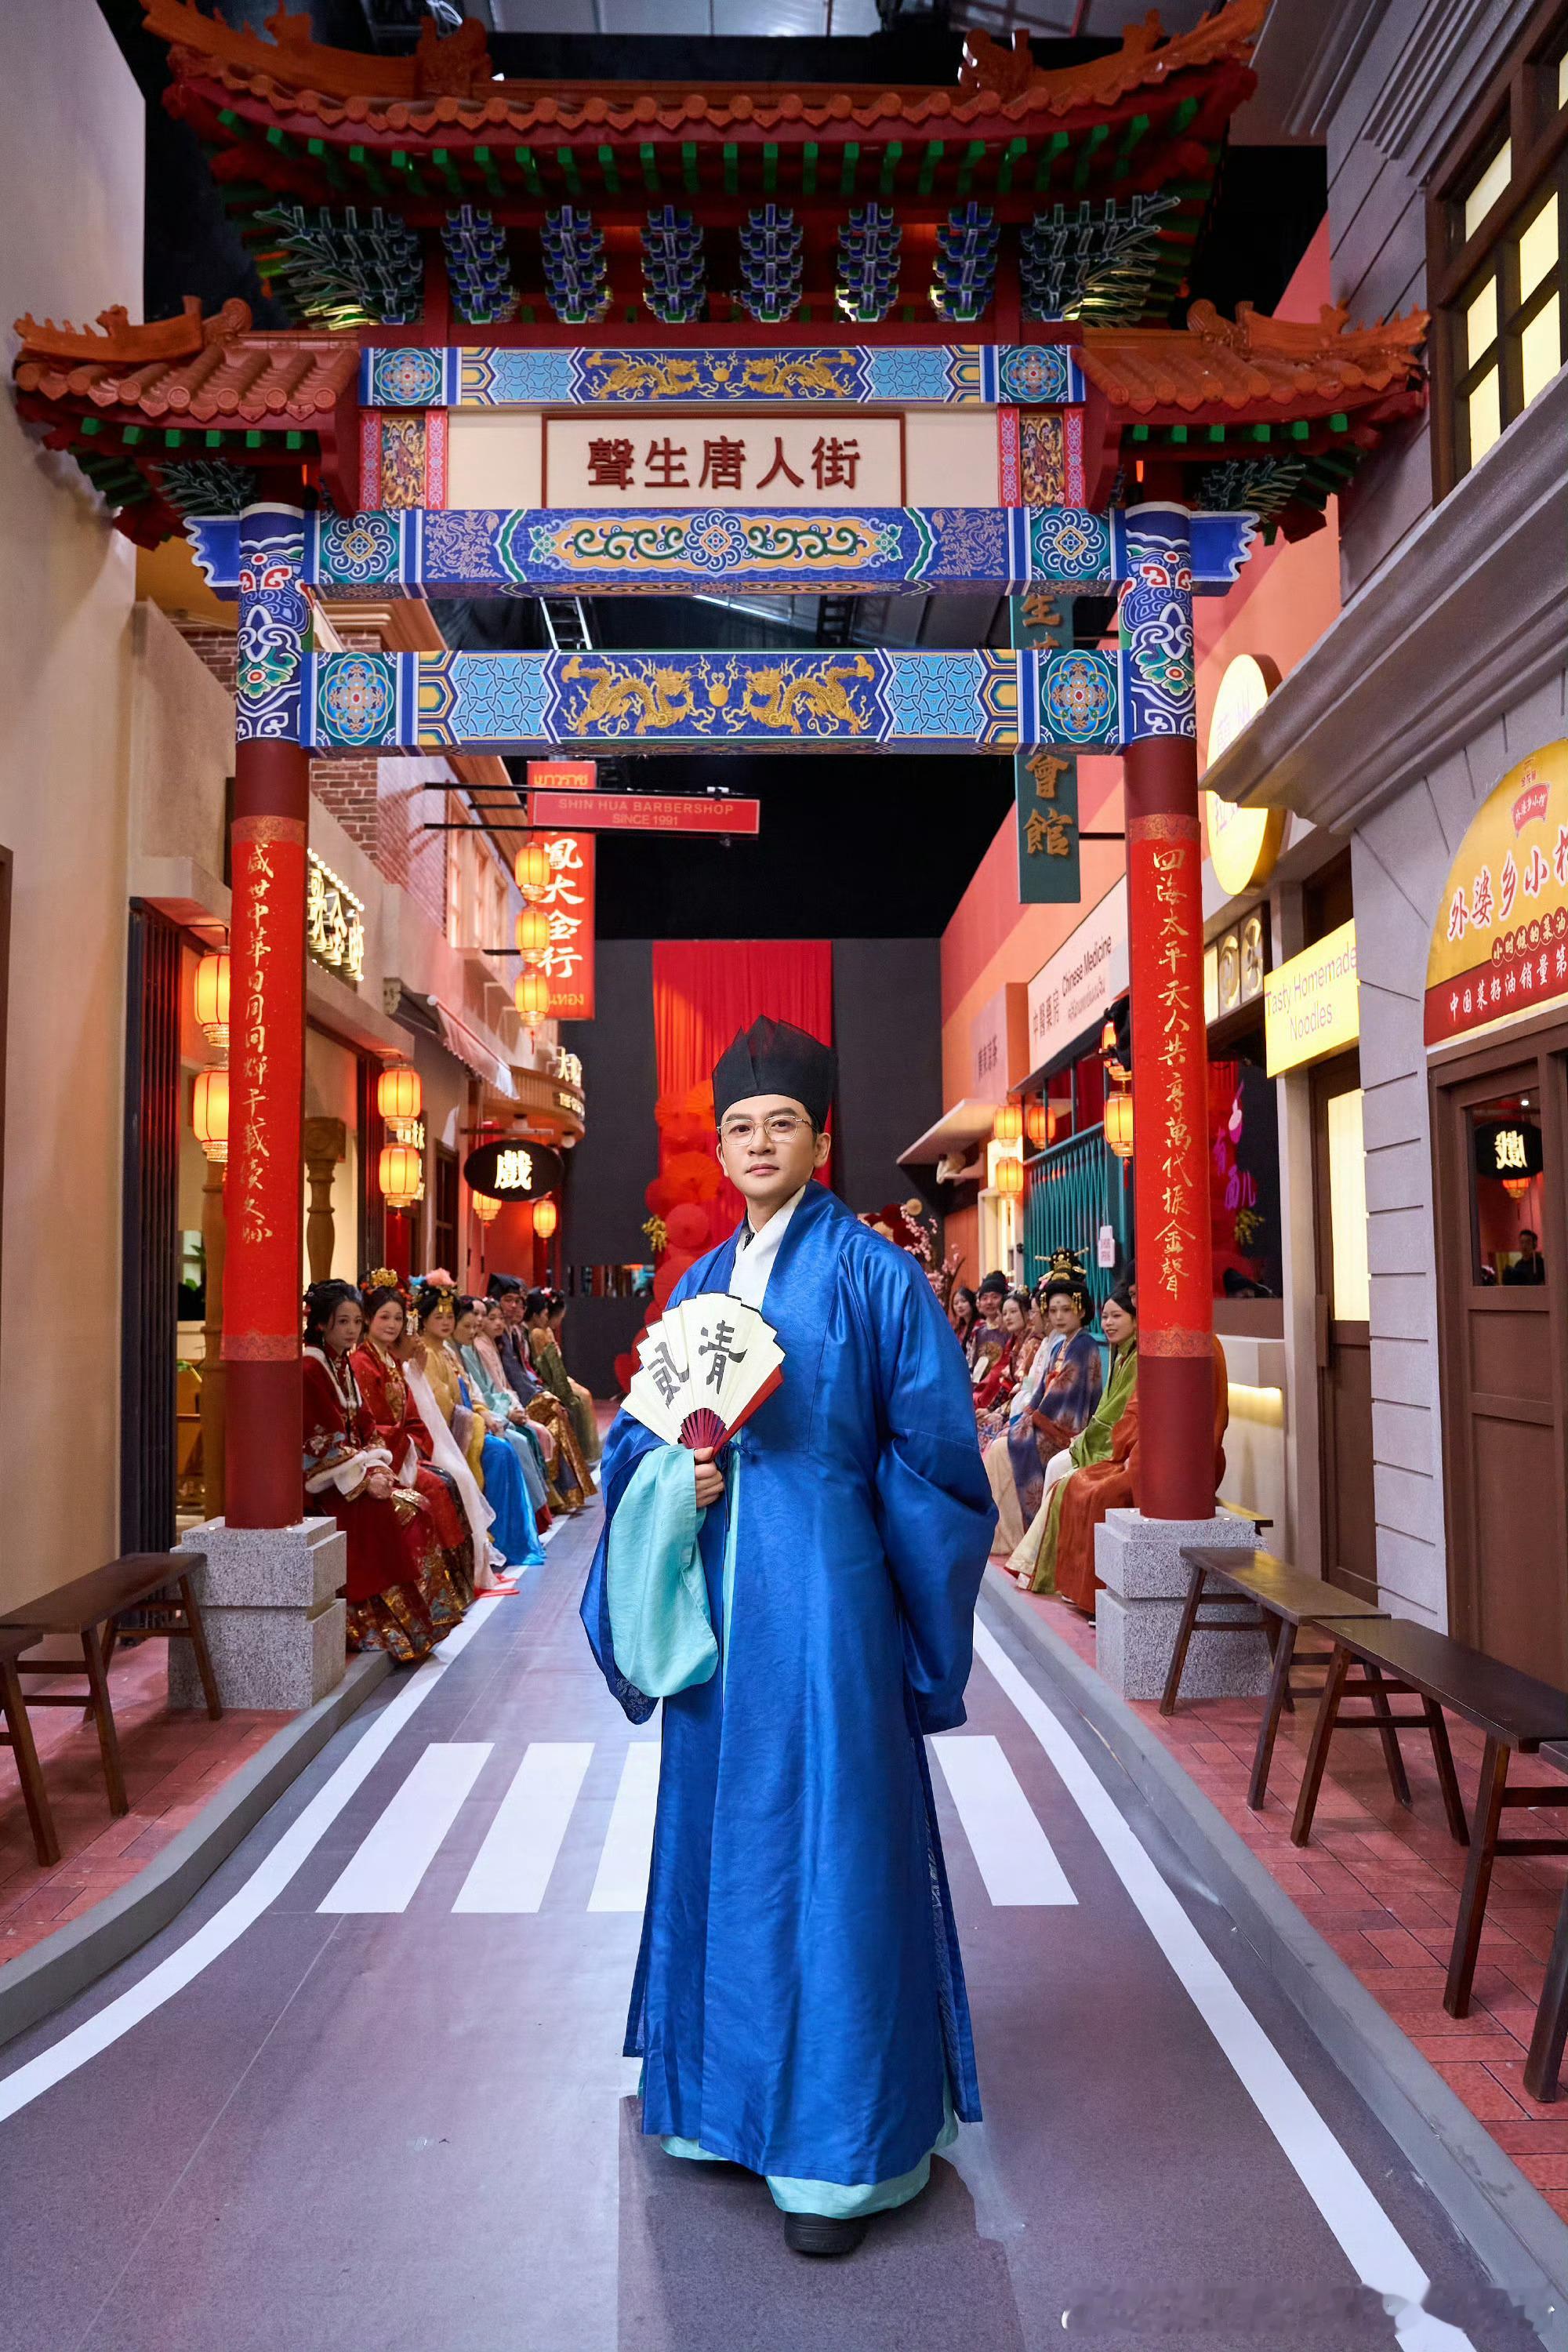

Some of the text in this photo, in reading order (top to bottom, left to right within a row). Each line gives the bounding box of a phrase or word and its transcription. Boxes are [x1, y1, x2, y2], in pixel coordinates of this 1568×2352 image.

[588, 436, 861, 490] 聲生唐人街
[558, 798, 734, 815] SHIN HUA BARBERSHOP
[612, 814, 678, 826] SINCE 1991
[1062, 935, 1112, 997] Chinese Medicine
[1265, 940, 1357, 1017] Tasty Homemade
[1290, 1000, 1333, 1042] Noodles
